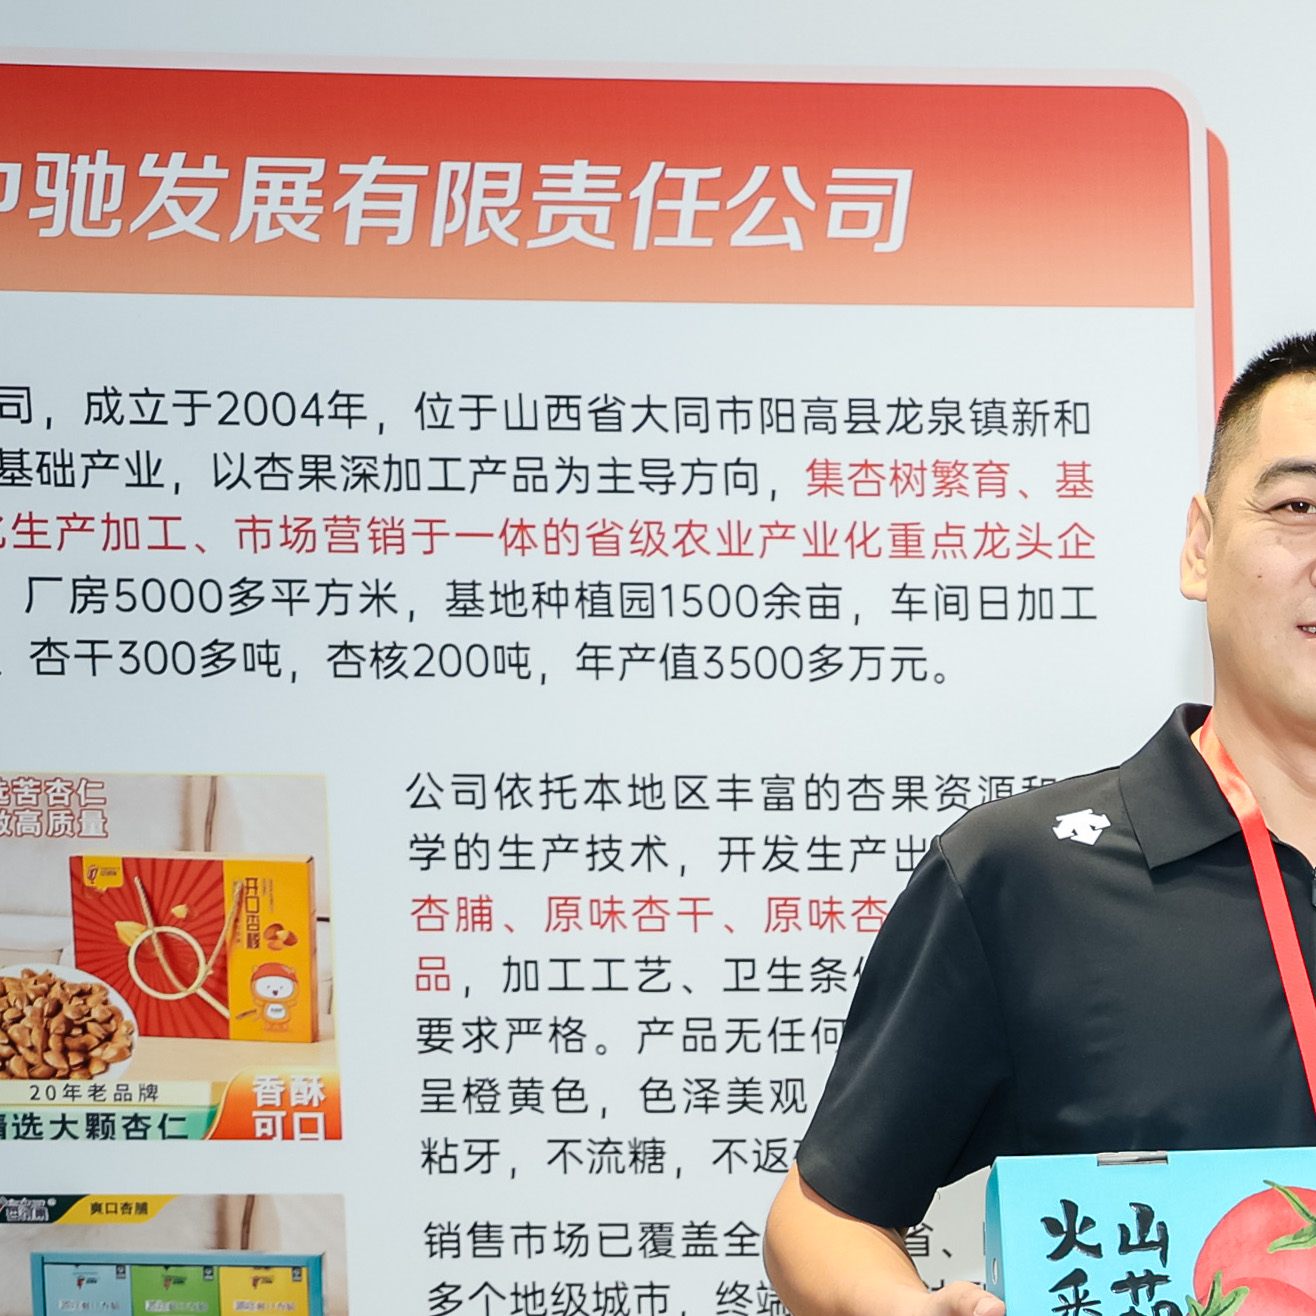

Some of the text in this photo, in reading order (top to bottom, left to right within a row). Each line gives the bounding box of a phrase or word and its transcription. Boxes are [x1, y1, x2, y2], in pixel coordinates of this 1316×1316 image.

[0, 510, 1096, 560] 生产加工、市场营销于一体的省级农业产业化重点龙头企
[29, 1082, 160, 1102] 20年老品牌
[420, 1137, 798, 1180] 粘牙，不流糖，不返
